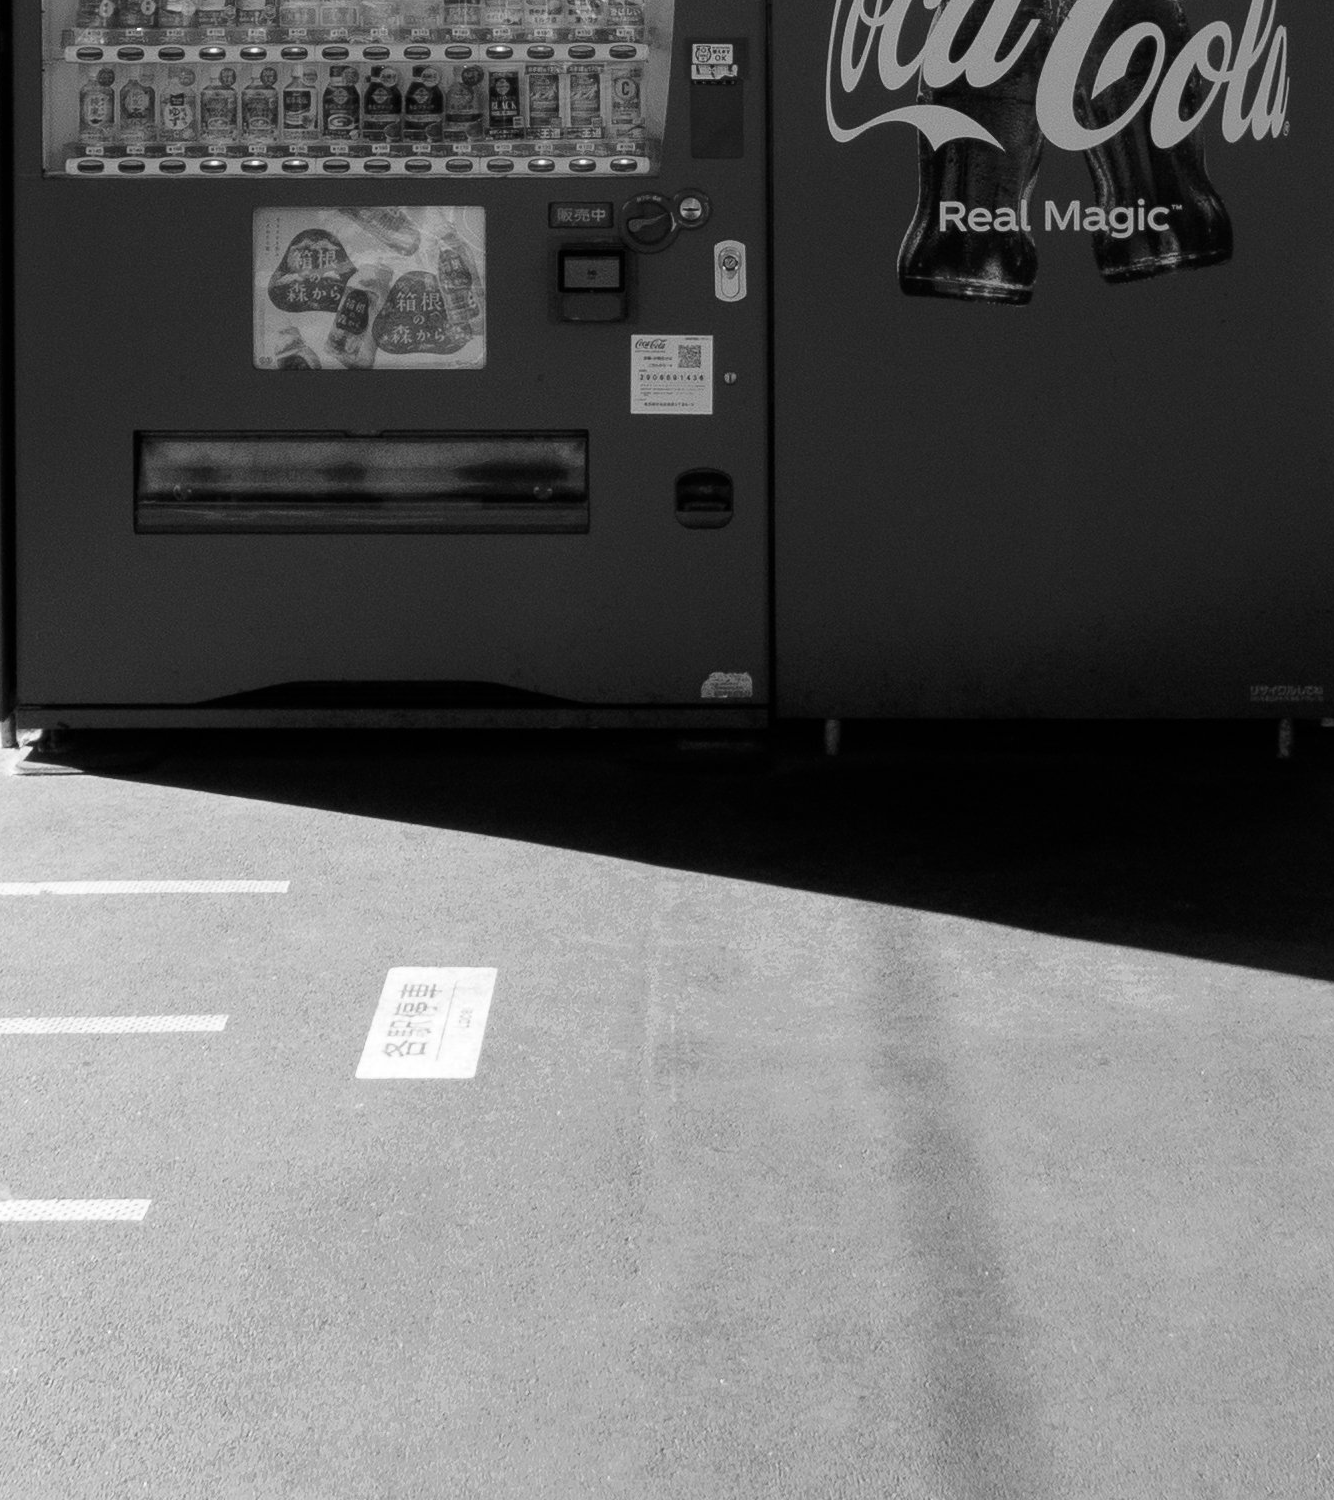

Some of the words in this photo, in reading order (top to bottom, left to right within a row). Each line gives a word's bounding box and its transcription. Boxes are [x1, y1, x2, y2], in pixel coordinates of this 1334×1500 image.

[556, 207, 606, 223] 販売中
[939, 201, 1031, 233] Real
[293, 248, 339, 270] 箱根
[309, 273, 321, 283] の
[286, 284, 342, 303] 森から
[395, 291, 443, 313] 箱根
[413, 314, 426, 326] の
[390, 325, 446, 344] 森から
[382, 983, 443, 1057] 各駅停車
